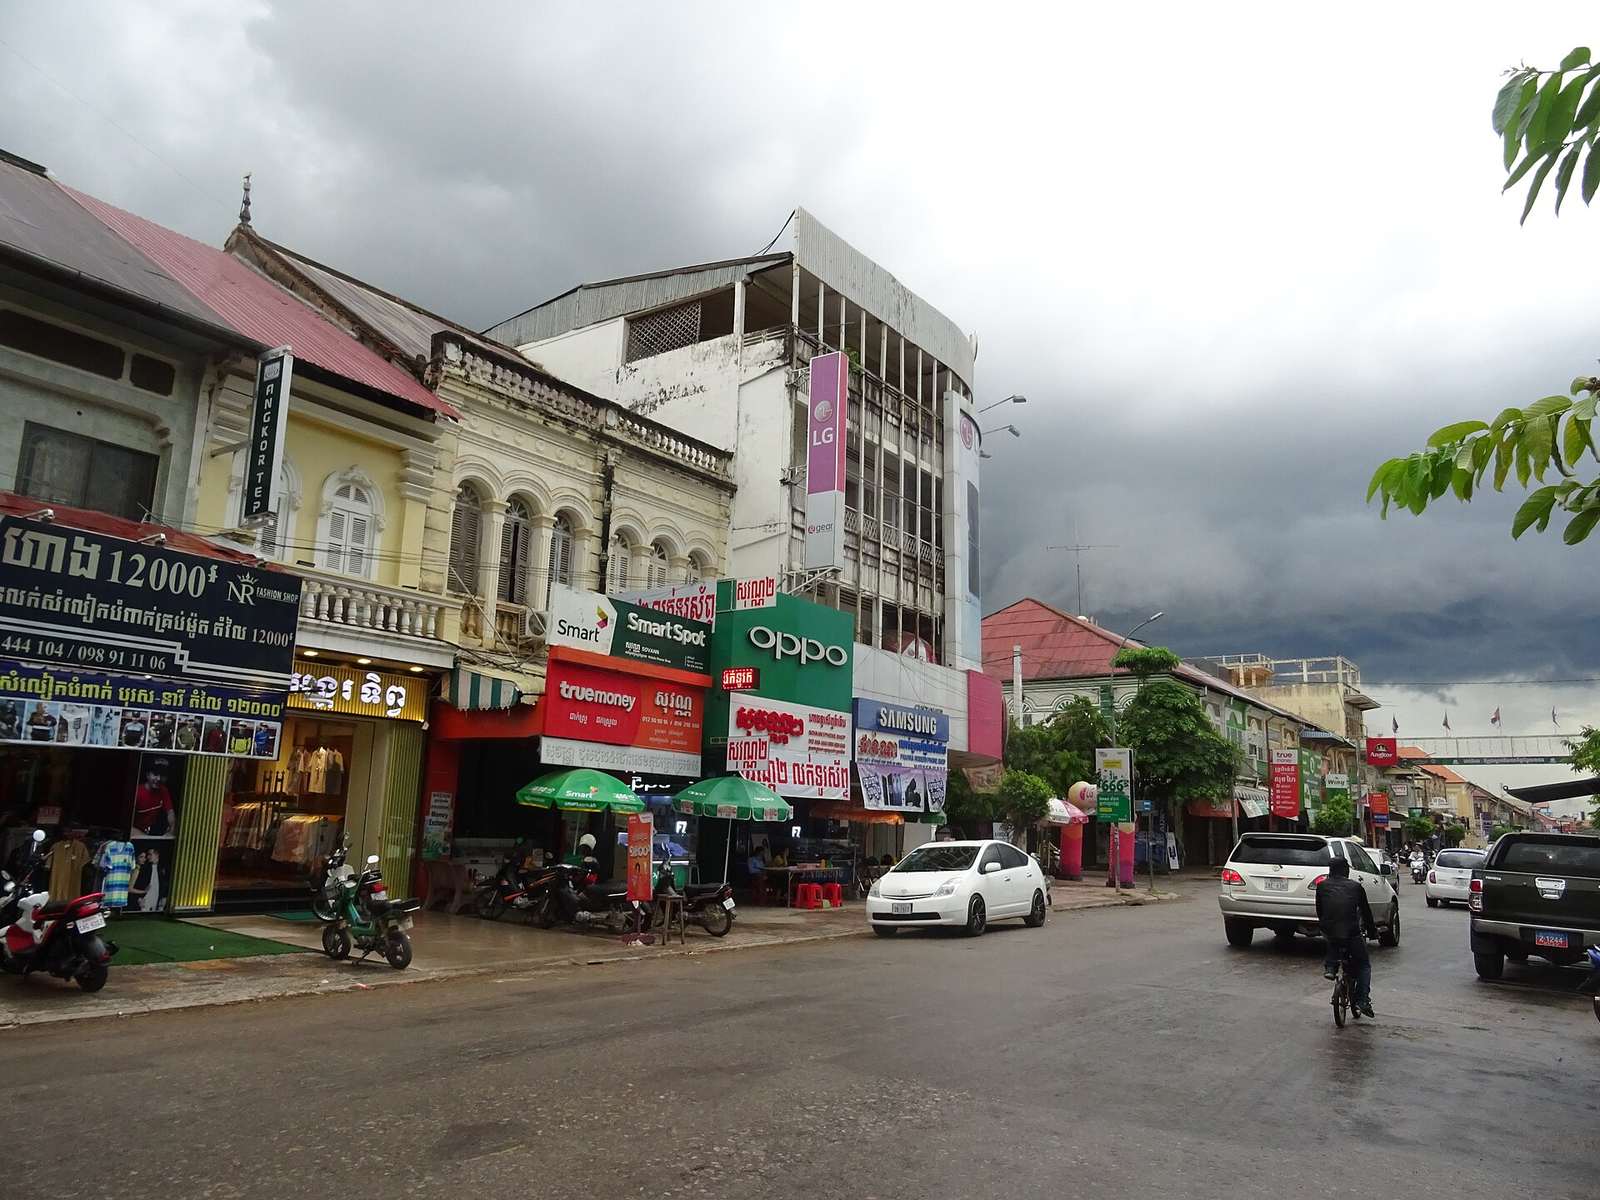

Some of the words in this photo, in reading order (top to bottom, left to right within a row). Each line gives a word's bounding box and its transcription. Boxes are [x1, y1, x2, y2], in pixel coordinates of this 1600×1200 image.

[257, 383, 274, 467] ANGKOR
[812, 427, 834, 447] LG
[252, 471, 265, 513] TEP
[2, 527, 102, 580] ហាង
[256, 586, 283, 601] FASHION
[283, 591, 300, 603] SHOP
[557, 619, 601, 643] Smart
[1, 636, 31, 653] 444
[37, 640, 64, 658] 104
[66, 644, 75, 658] /
[78, 645, 105, 663] 098
[109, 650, 125, 665] 91
[131, 653, 144, 668] 11
[150, 655, 166, 670] 06
[879, 707, 937, 736] SAMSUNG
[565, 789, 593, 799] Smart
